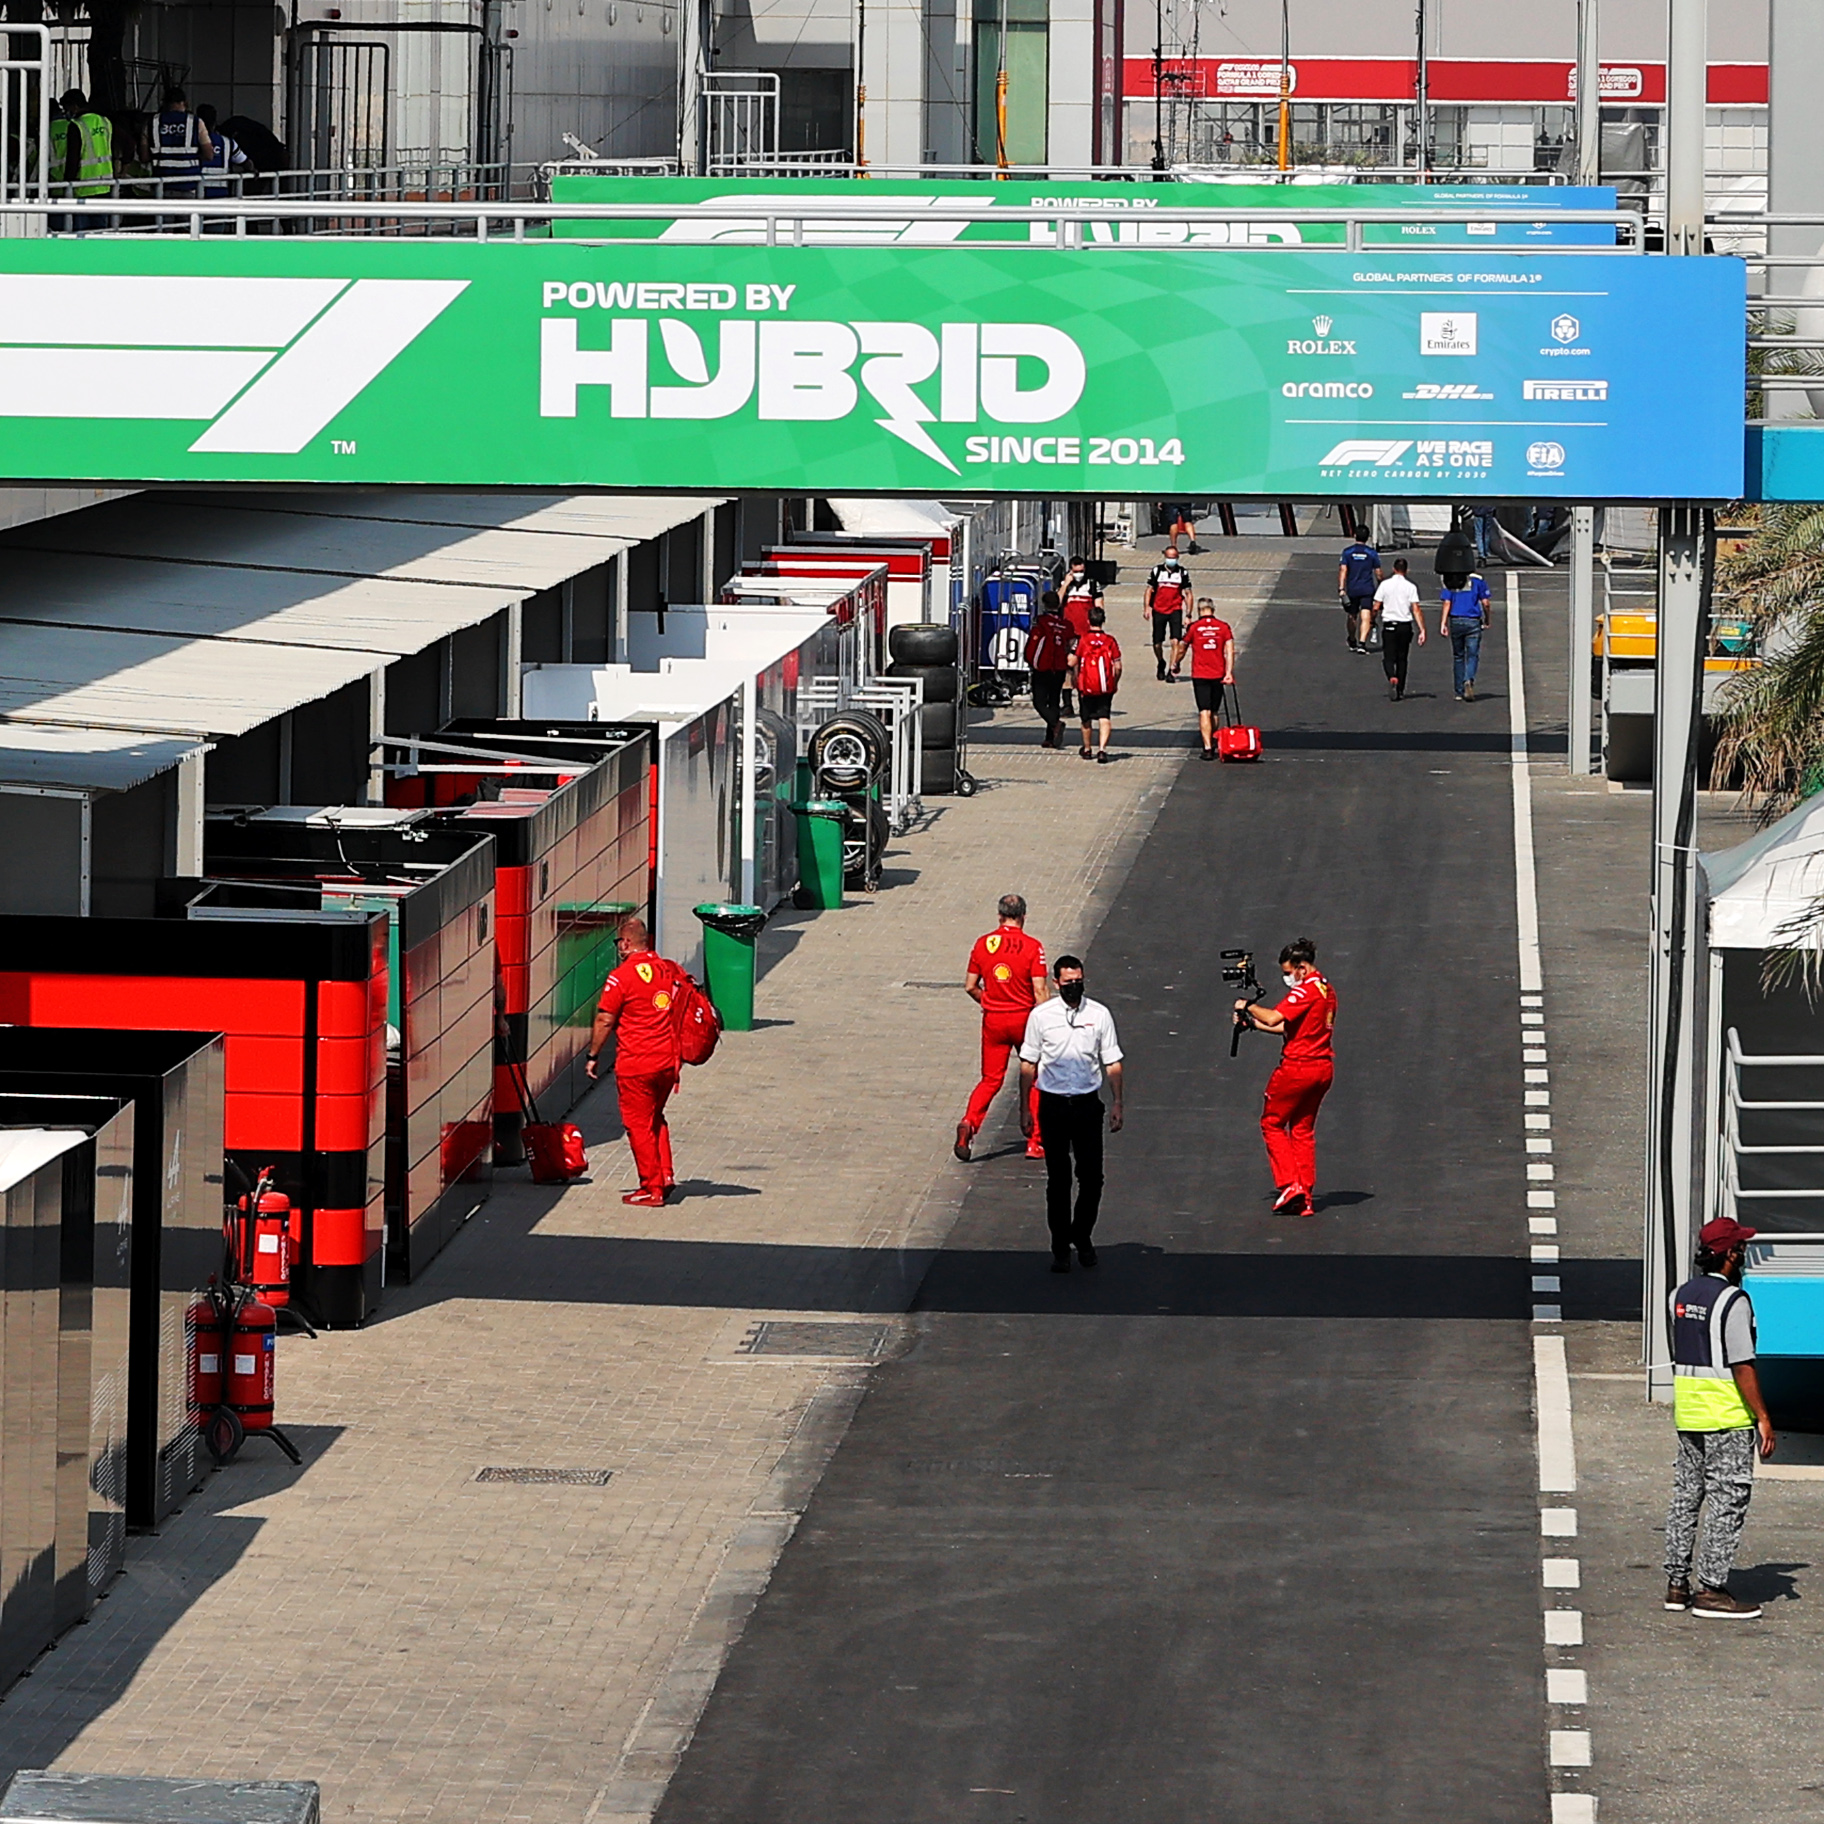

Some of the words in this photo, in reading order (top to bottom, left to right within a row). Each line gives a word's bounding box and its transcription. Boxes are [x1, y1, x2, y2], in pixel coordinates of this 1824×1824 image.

[1401, 226, 1436, 234] ROLEX
[1353, 272, 1395, 282] GLOBAL
[1396, 273, 1453, 283] PARTNERS
[1457, 274, 1472, 283] OF
[1474, 274, 1527, 283] FORMULA
[543, 281, 736, 309] POWERED
[745, 284, 796, 311] BY
[1287, 340, 1357, 355] ROLEX
[1427, 339, 1470, 349] Emirates
[1540, 347, 1591, 356] crypto.com
[540, 318, 1086, 476] HYBRID
[1281, 382, 1374, 399] aramco
[1415, 384, 1481, 399] DHL
[1523, 380, 1608, 401] PIRELLI
[965, 437, 1080, 464] SINCE
[1088, 438, 1185, 466] 2014
[1416, 441, 1446, 453] WE
[1448, 441, 1492, 454] RACE
[1416, 454, 1444, 467] AS
[1450, 455, 1492, 468] ONE
[1320, 469, 1342, 477] NET
[1384, 470, 1430, 478] CARBON
